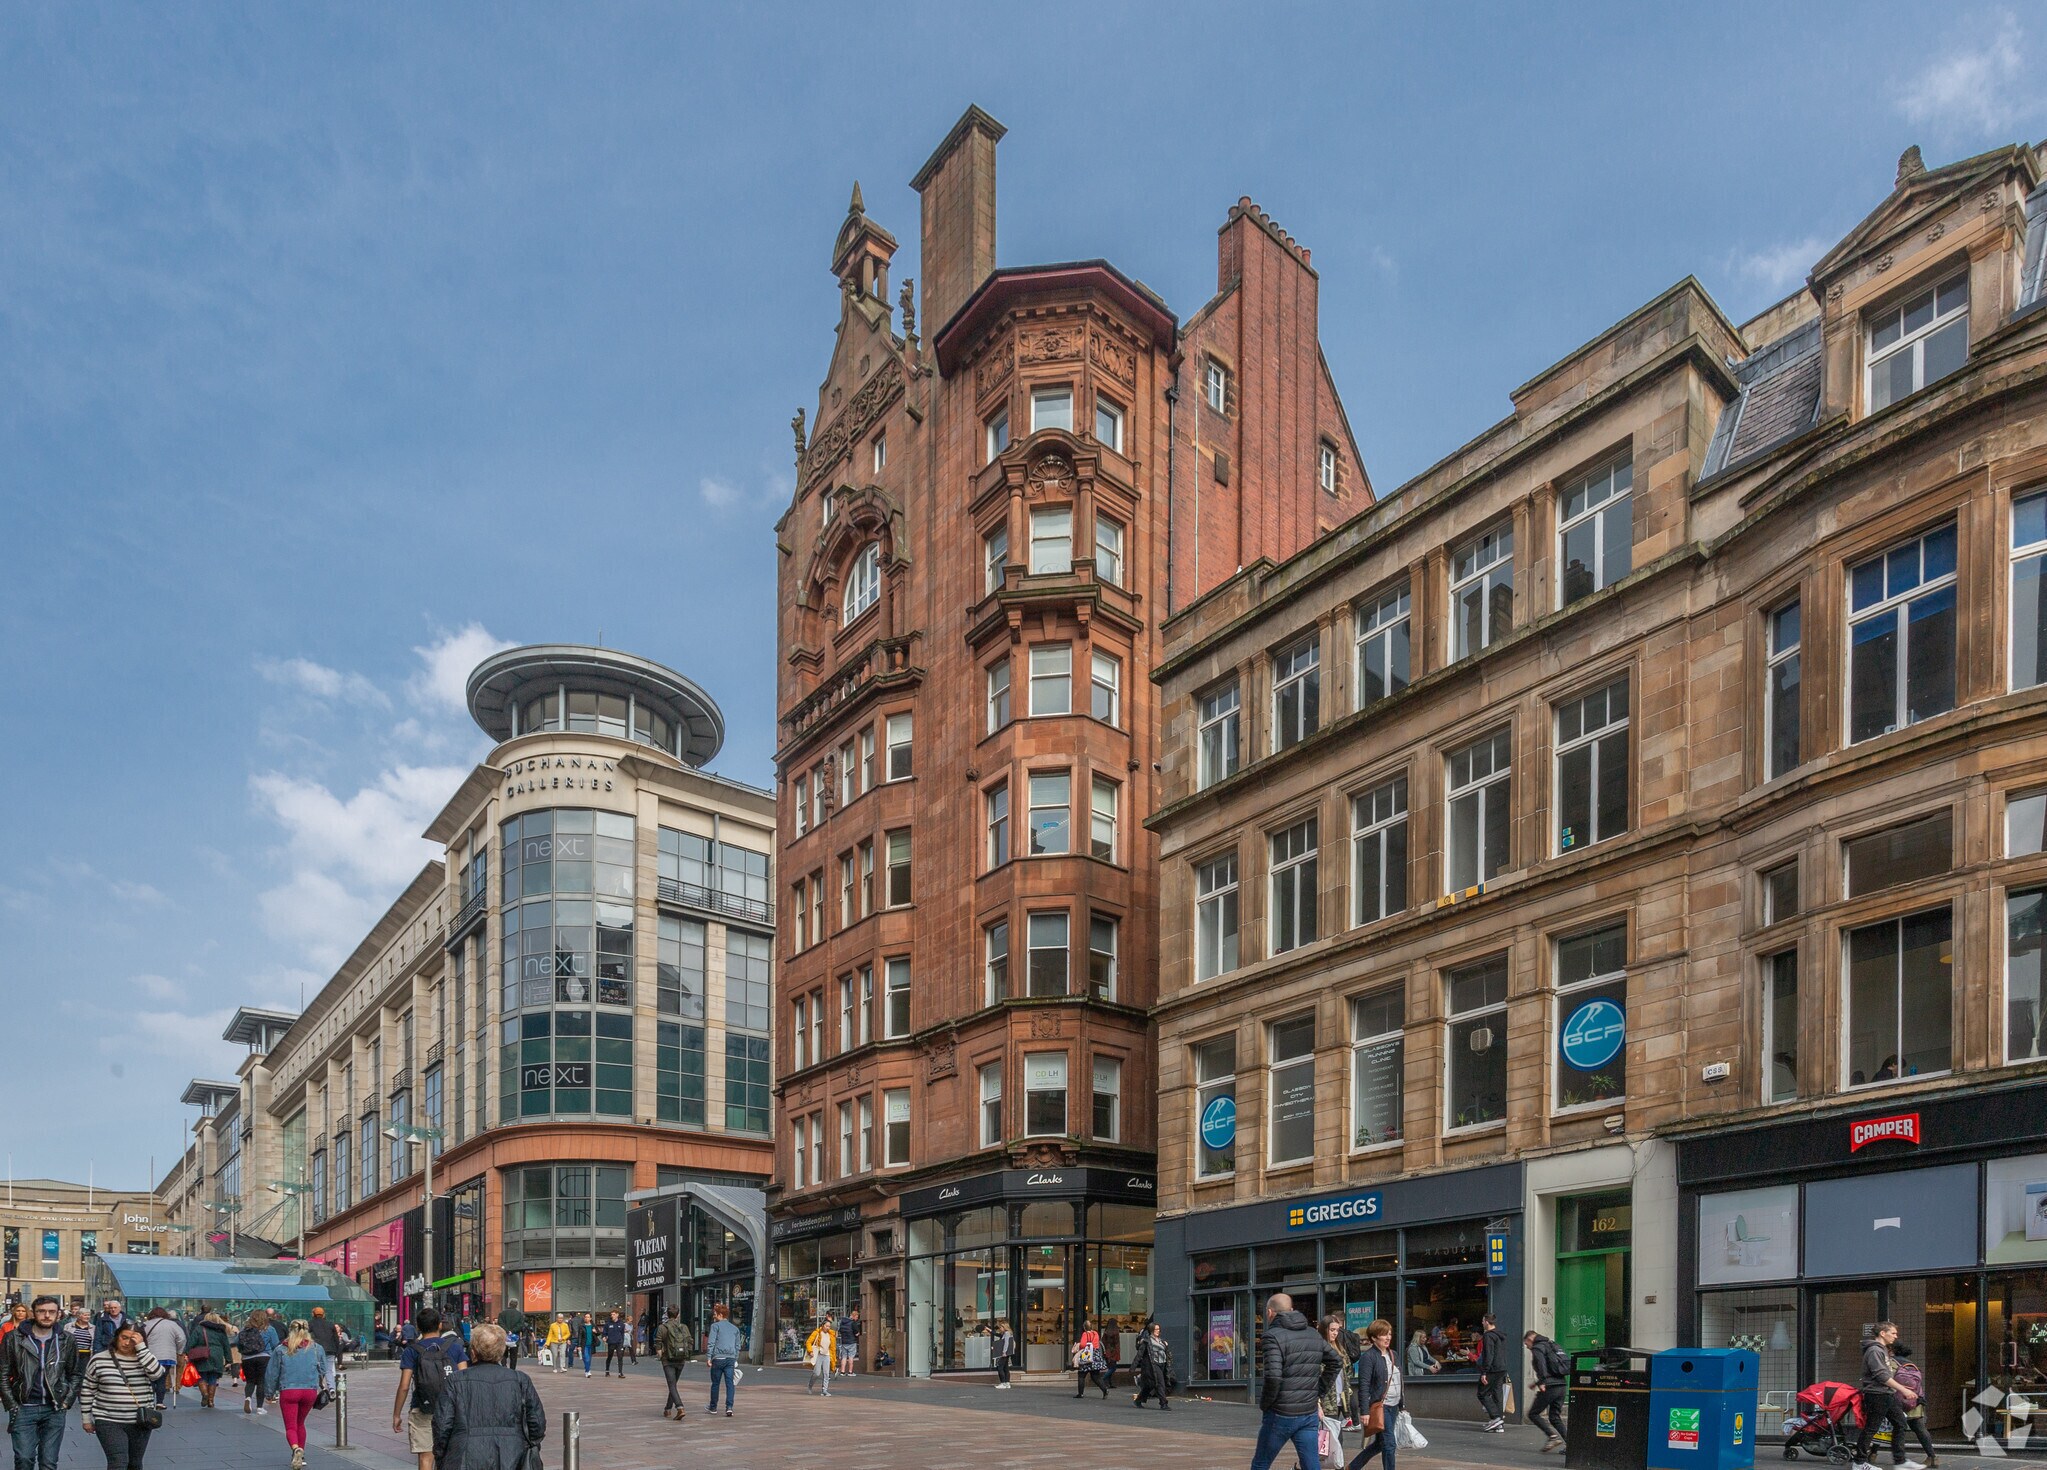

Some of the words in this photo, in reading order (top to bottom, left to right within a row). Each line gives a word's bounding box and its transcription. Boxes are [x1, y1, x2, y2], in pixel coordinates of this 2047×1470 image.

[505, 757, 614, 779] BUCHANAN
[507, 777, 613, 798] GALLERIES
[526, 838, 585, 859] next
[525, 955, 585, 977] next
[1564, 1023, 1625, 1047] GCP
[524, 1066, 584, 1087] next
[1707, 1066, 1724, 1076] CSS
[1854, 1118, 1914, 1144] CAMPER
[1027, 1173, 1063, 1186] Clarks
[1127, 1177, 1153, 1190] Clarks
[938, 1187, 961, 1200] Clarks
[123, 1213, 149, 1225] John
[1306, 1197, 1378, 1223] GREGGS
[135, 1223, 167, 1233] Lewis
[1592, 1217, 1616, 1232] 162
[634, 1235, 667, 1257] TARTAN
[637, 1257, 665, 1277] HOUSE
[225, 1300, 289, 1313] subway
